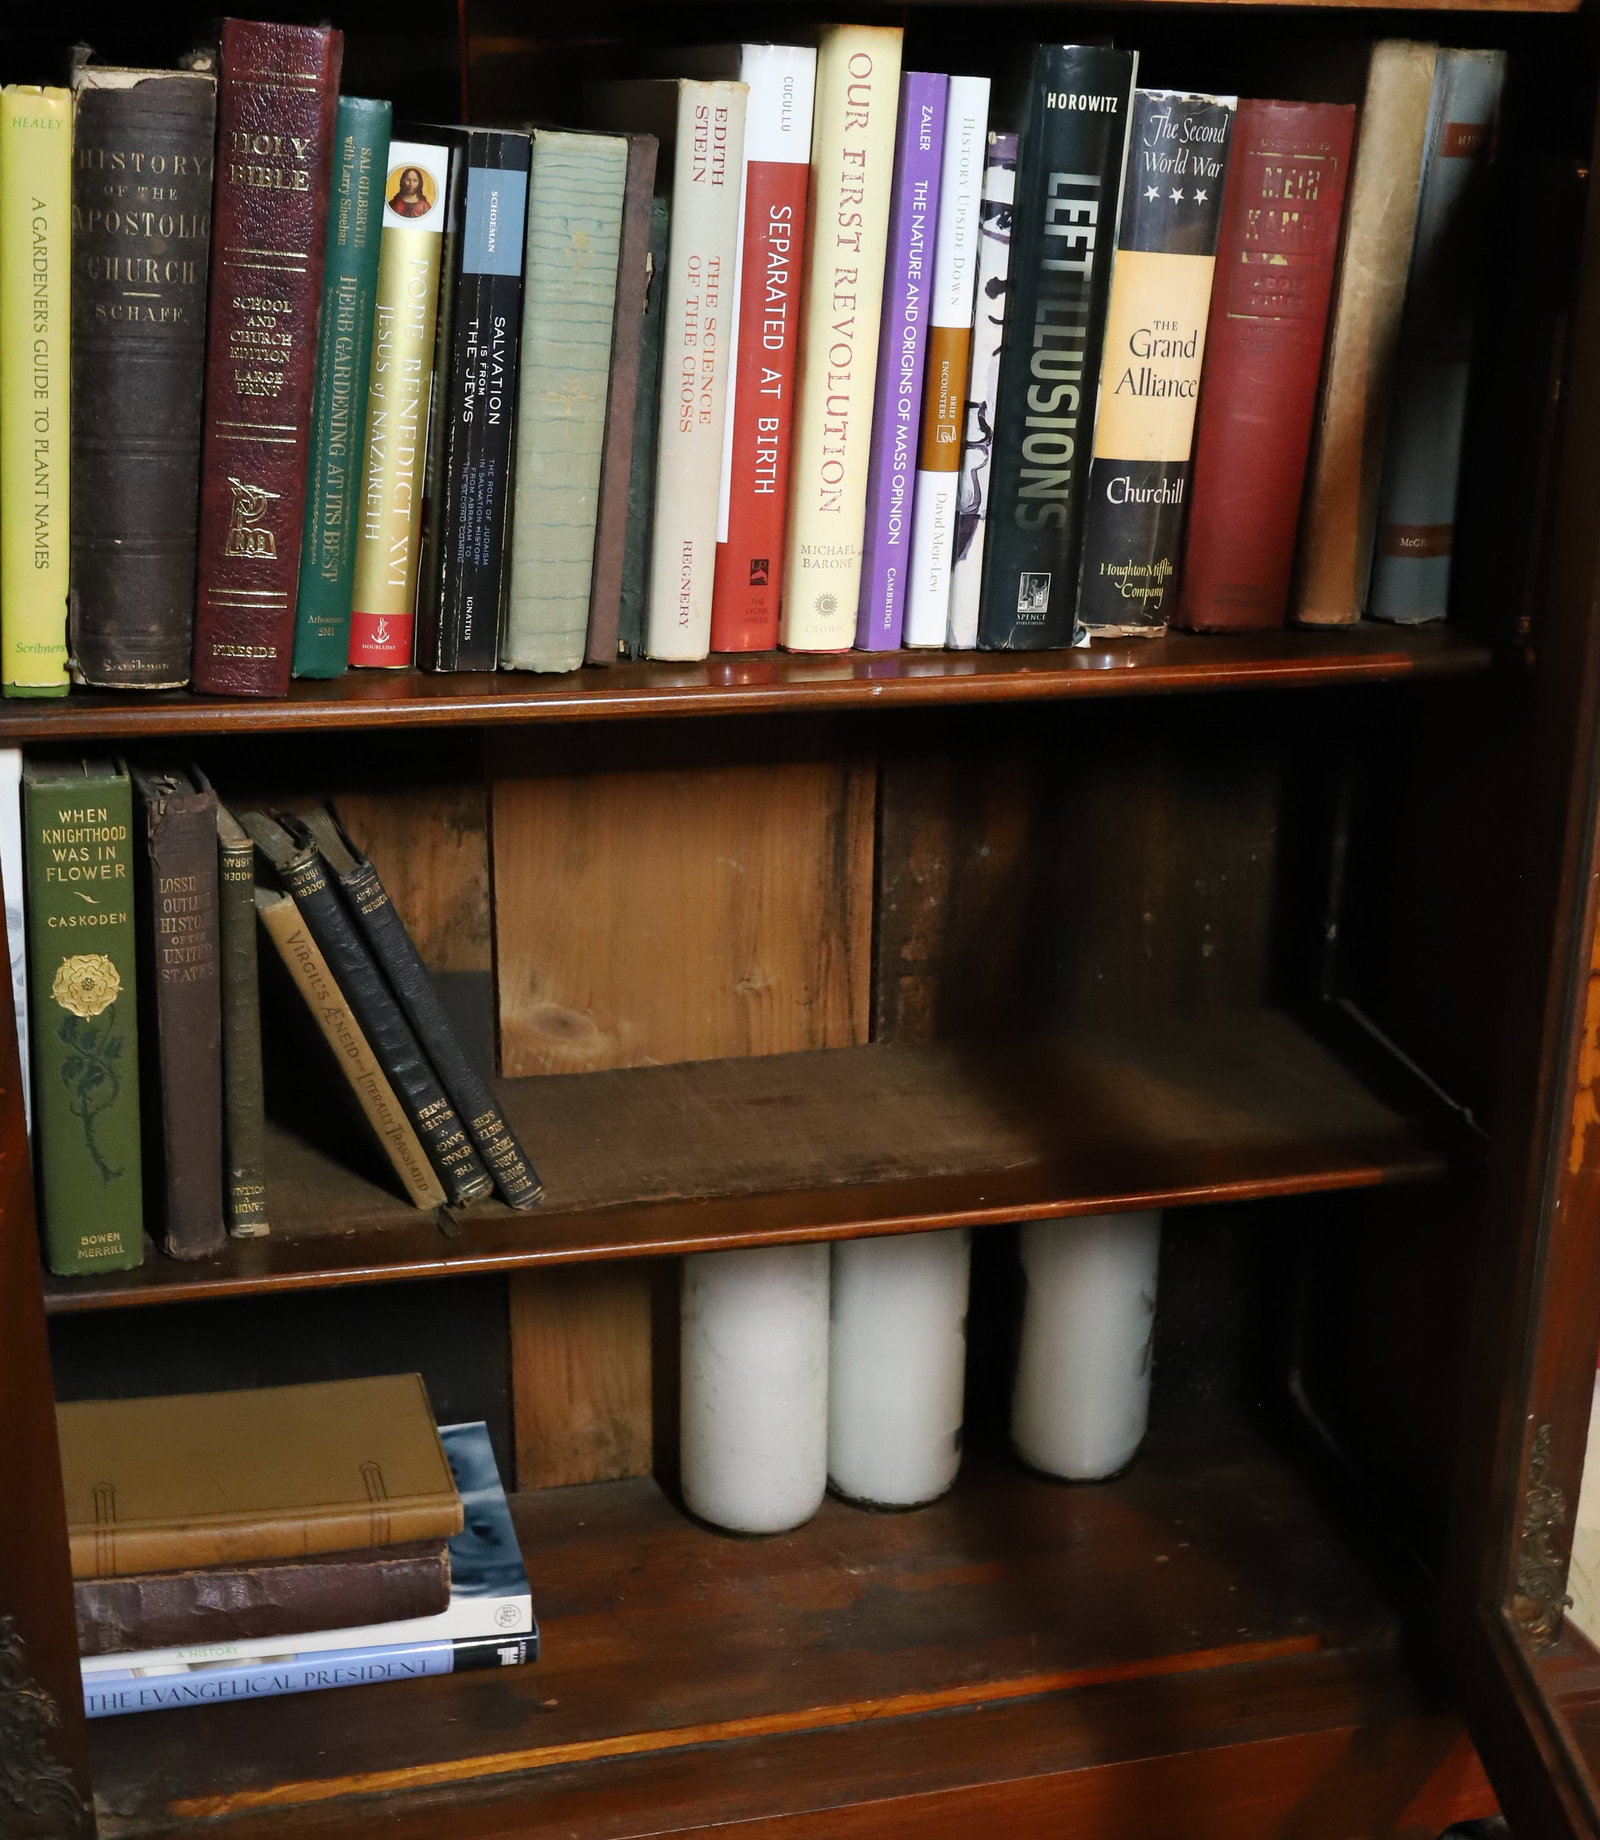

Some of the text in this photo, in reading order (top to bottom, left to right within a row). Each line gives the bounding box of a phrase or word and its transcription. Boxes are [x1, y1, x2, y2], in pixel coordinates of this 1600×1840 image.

[781, 76, 793, 132] CUCULLU
[1047, 93, 1118, 113] HOROWITZ
[12, 117, 64, 130] HEALEY
[919, 105, 933, 151] ZALLER
[1144, 107, 1178, 147] The
[1180, 114, 1228, 143] Second
[231, 131, 310, 158] HOLY
[693, 105, 709, 183] STEIN
[712, 107, 728, 187] EDITH
[959, 118, 975, 187] HISTORY
[77, 150, 209, 176] HISTORY
[229, 163, 309, 191] BIBLE
[1144, 148, 1224, 178] World War
[104, 184, 178, 201] OF THE
[338, 136, 353, 246] with Larry Sheehan
[355, 147, 371, 247] SAL GILBERTIE
[488, 191, 498, 253] SCHOEMAN
[88, 258, 196, 284] CHURCH
[819, 53, 873, 514] OUR FIRST REVOLUTION
[233, 297, 292, 313] SCHOOL
[247, 316, 276, 328] AND
[1154, 320, 1178, 331] THE
[230, 331, 292, 346] CHURCH
[679, 256, 701, 433] OF THE CROSS
[699, 256, 720, 424] THE SCIENCE
[754, 205, 792, 494] SEPARATED AT BIRTH
[1014, 172, 1101, 531] LEFT ILLUSIONS
[1129, 329, 1198, 359] Grand
[229, 347, 291, 363] EDITION
[888, 180, 928, 545] THE NATURE AND ORIGINS OF MASS OPINION
[32, 197, 50, 570] A GARDENER'S GUIDE TO PLANT NAMES
[234, 370, 284, 384] LARGE
[463, 319, 479, 422] THE JEWS
[478, 346, 488, 396] IS FROM
[488, 317, 506, 424] SALVATION
[1114, 367, 1198, 398] Alliance
[236, 383, 282, 397] PRINT
[938, 361, 949, 419] ENCOUNTERS
[322, 276, 357, 582] HERB GARDENING AT ITS BEST
[365, 303, 395, 540] JESUS of NAZARETH
[388, 259, 428, 587] POPE BENEDICT XVI
[480, 459, 485, 468] IN
[460, 484, 468, 522] SECOND
[477, 473, 485, 522] SALVATION
[486, 482, 494, 505] ROLE
[1106, 477, 1183, 504] Churchill
[485, 509, 492, 521] OF
[465, 545, 472, 557] TO
[482, 526, 490, 566] JUDAISM
[801, 544, 855, 555] MICHAEL
[929, 493, 948, 592] David Meir-Levi
[803, 558, 853, 569] BARONE
[1099, 557, 1173, 588] Houghton Mifflin
[679, 540, 692, 628] REGNERY
[884, 568, 896, 630] CAMBRIDGE
[1122, 583, 1164, 609] Company
[464, 597, 473, 641] IGNATIUS
[804, 625, 844, 633] CROWN
[213, 644, 277, 658] FIRESIDE
[59, 808, 107, 823] WHEN
[42, 826, 127, 844] KNIGHTHOOD
[52, 846, 116, 862] WAS IN
[46, 864, 126, 882] FLOWER
[47, 912, 127, 927] CASKODEN
[287, 929, 330, 1000] VIRGIL'S
[357, 1071, 396, 1130] LITERALLY
[386, 1122, 429, 1193] TRANSLATED
[454, 1162, 475, 1179] THE
[77, 1244, 125, 1260] MERRILL
[81, 1231, 120, 1245] BOWEN
[177, 1646, 239, 1660] A HISTORY
[85, 1658, 431, 1713] THE EVANGELICAL PRESIDENT
